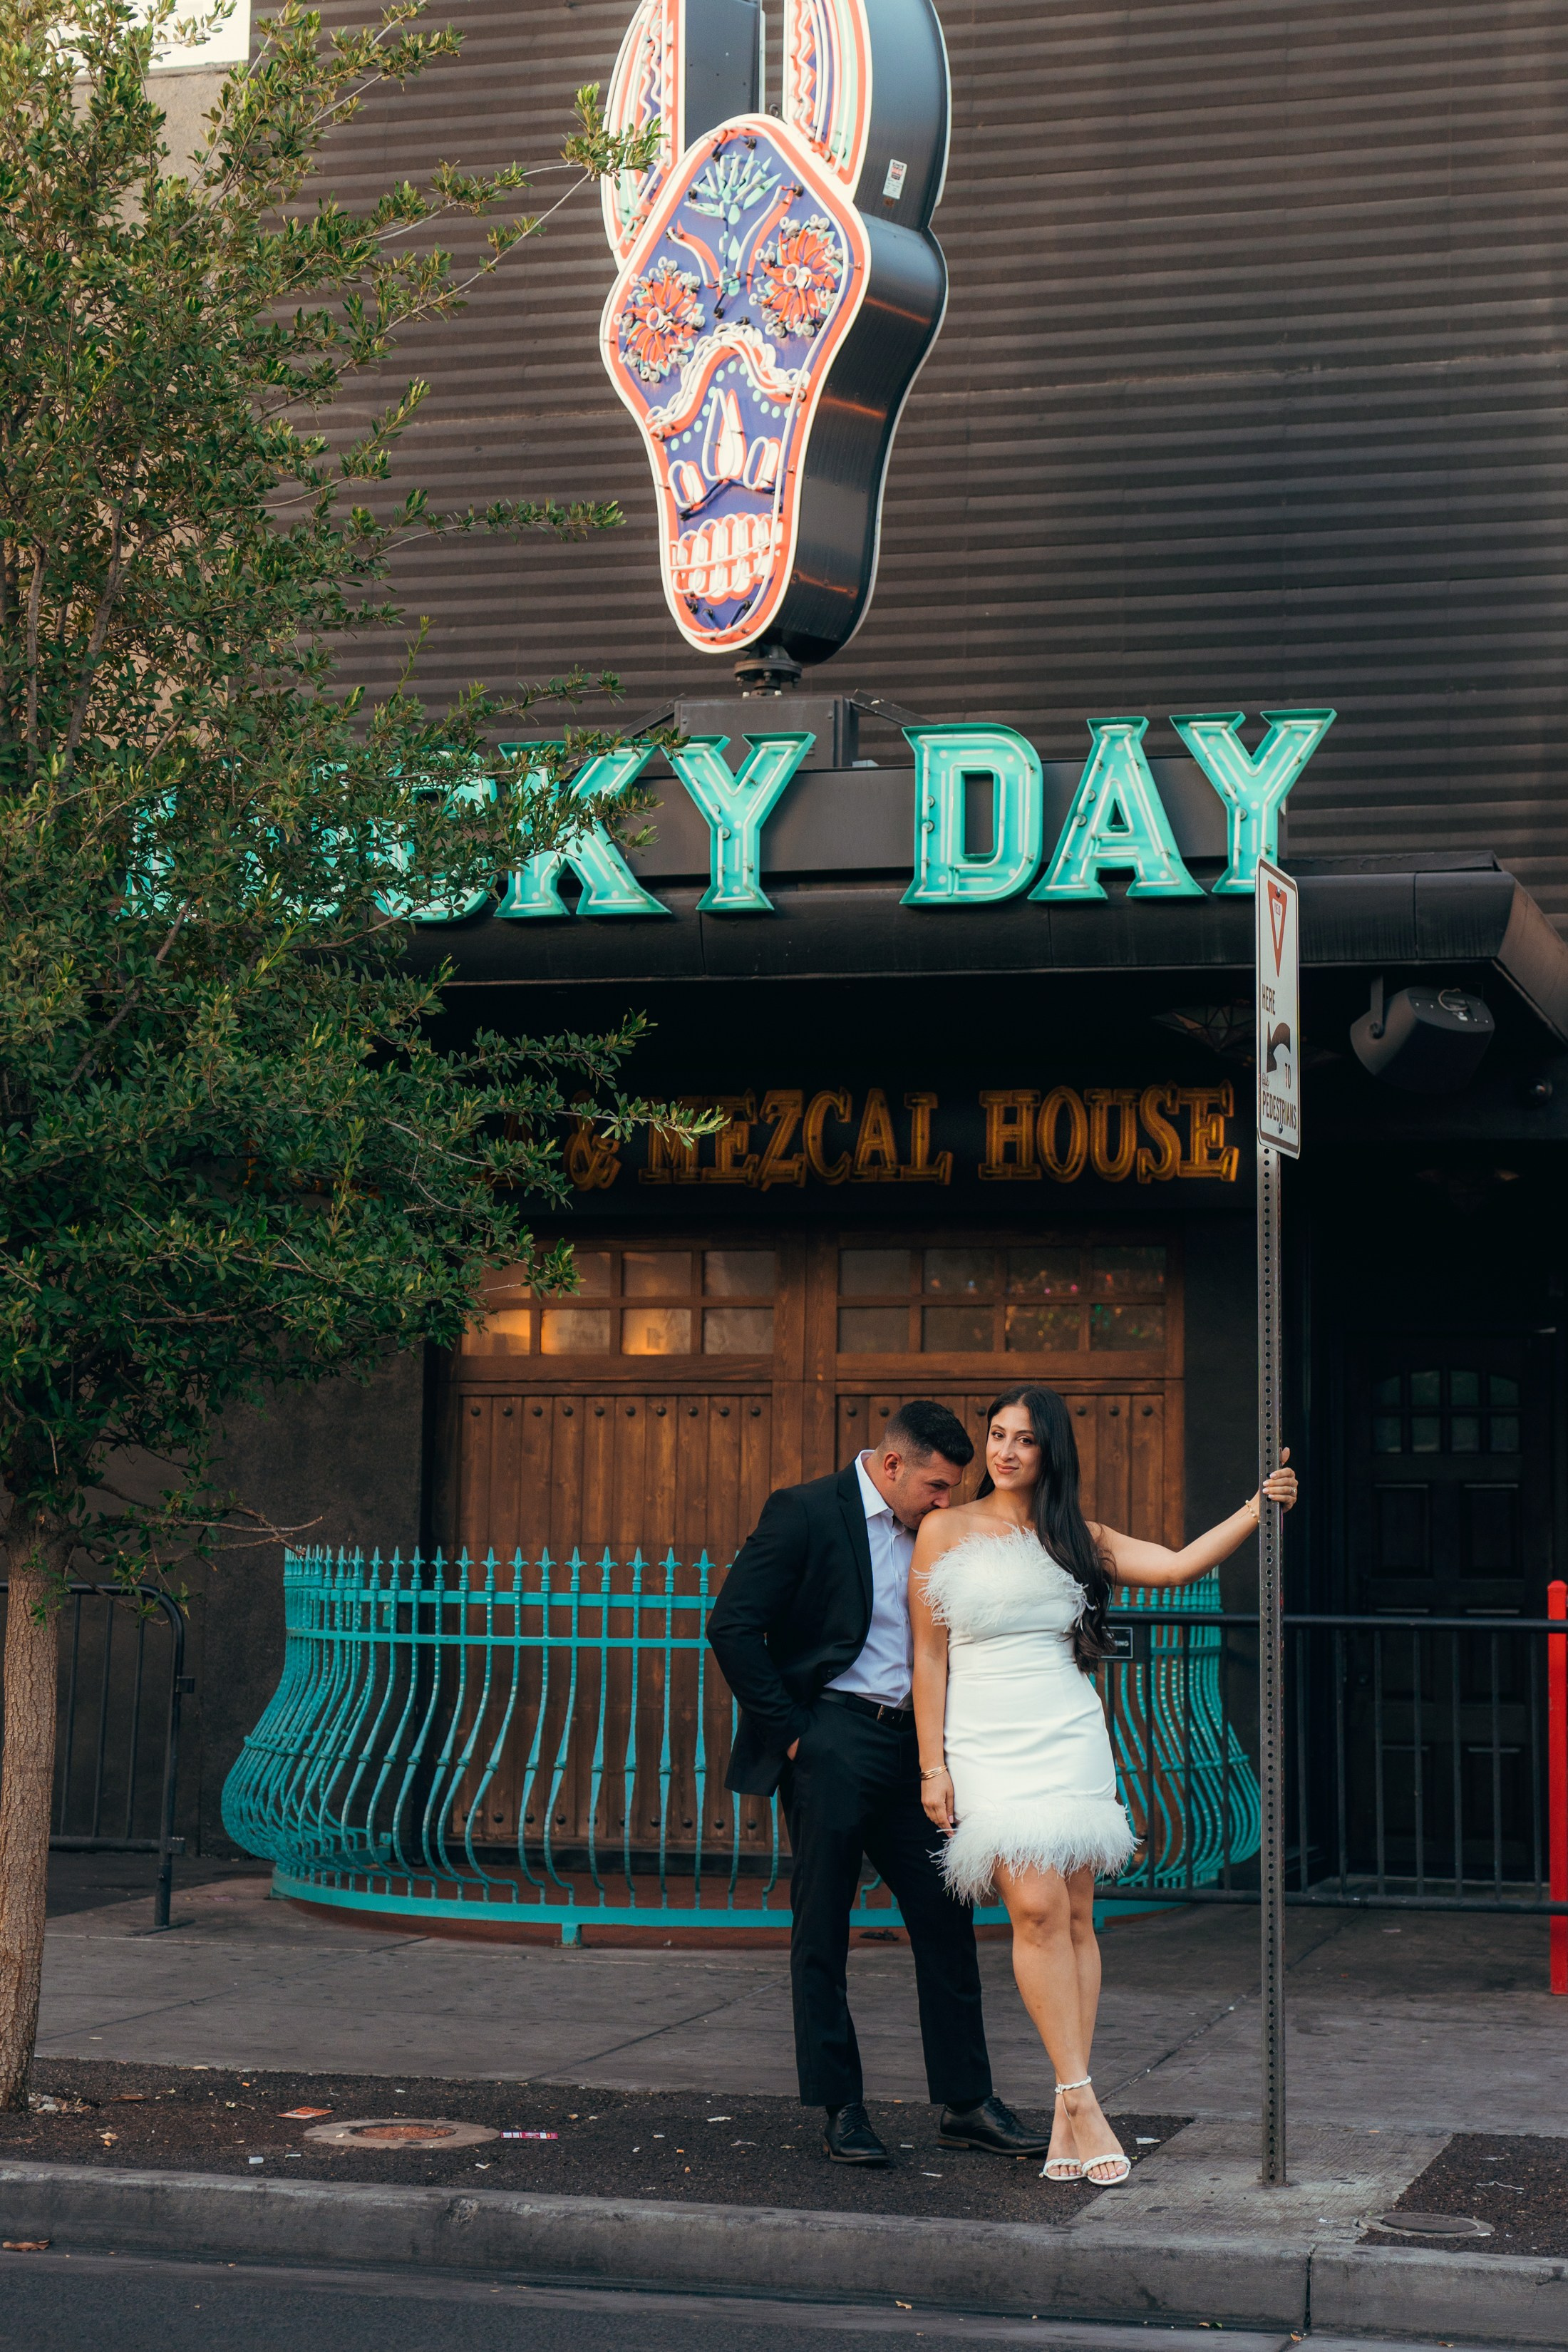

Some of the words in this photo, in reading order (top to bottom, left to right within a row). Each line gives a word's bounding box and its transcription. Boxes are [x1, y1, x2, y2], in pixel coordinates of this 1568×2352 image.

[900, 708, 1337, 906] DAY
[1262, 983, 1275, 1016] HERE
[1285, 1063, 1291, 1089] TO
[1262, 1090, 1296, 1130] PEDESTRIANS
[978, 1079, 1240, 1185] HOUSE
